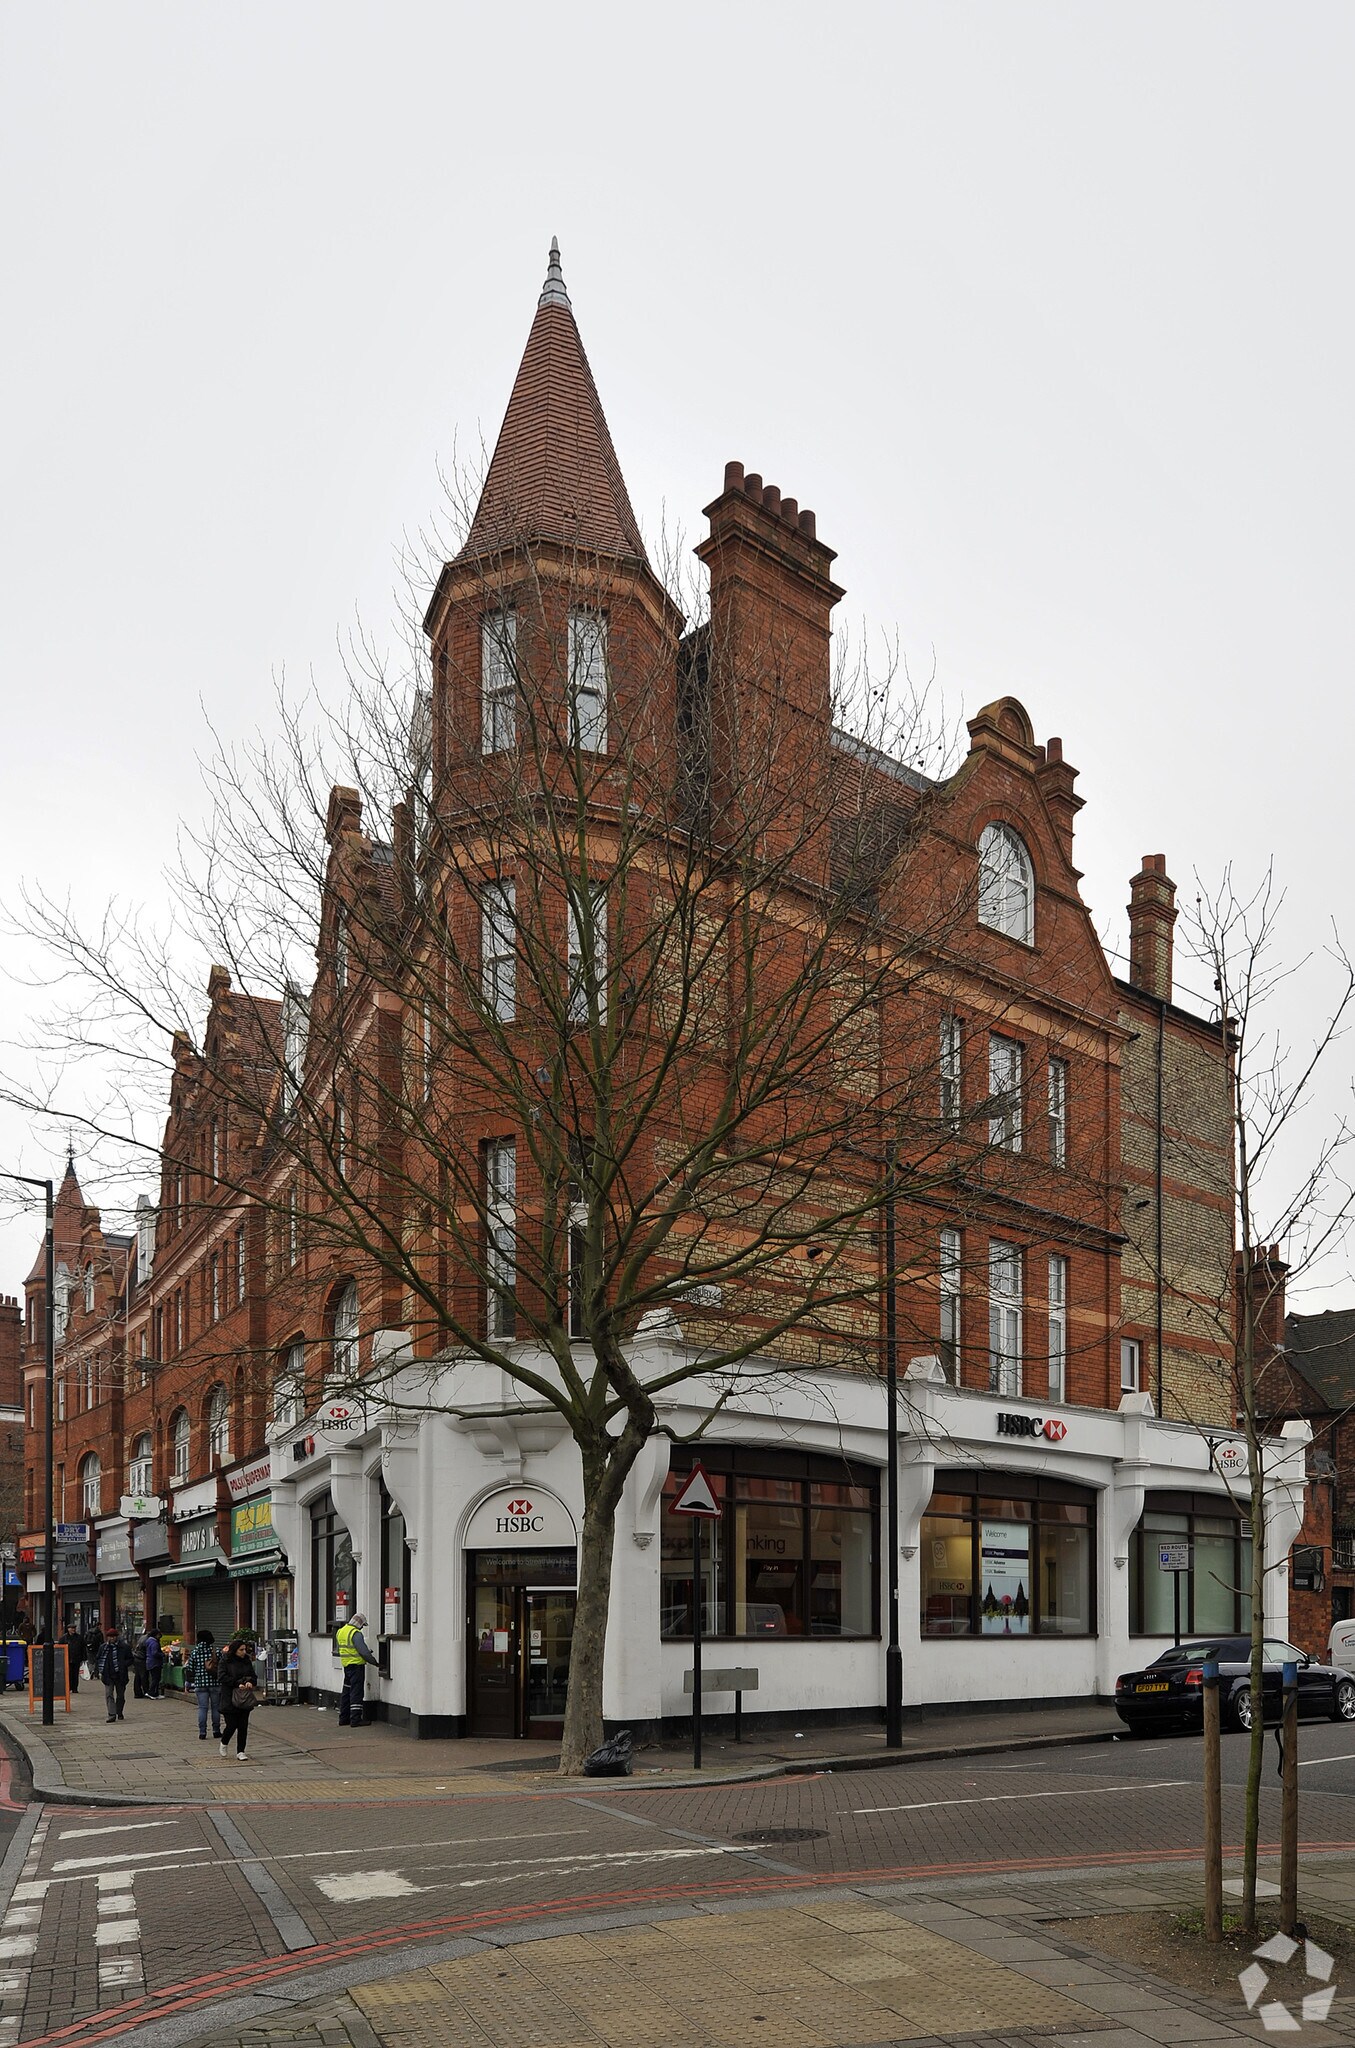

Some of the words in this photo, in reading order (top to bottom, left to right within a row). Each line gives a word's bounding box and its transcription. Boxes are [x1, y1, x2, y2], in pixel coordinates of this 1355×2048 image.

[322, 1419, 358, 1431] HSBC
[997, 1412, 1043, 1438] HSBC
[496, 1516, 544, 1533] HSBC
[182, 1527, 206, 1553] HARDY'S
[985, 1529, 1007, 1539] Welcome
[746, 1535, 786, 1554] nking
[486, 1557, 516, 1565] Welcome
[940, 1582, 957, 1591] HSBC
[1155, 1683, 1167, 1691] TYX
